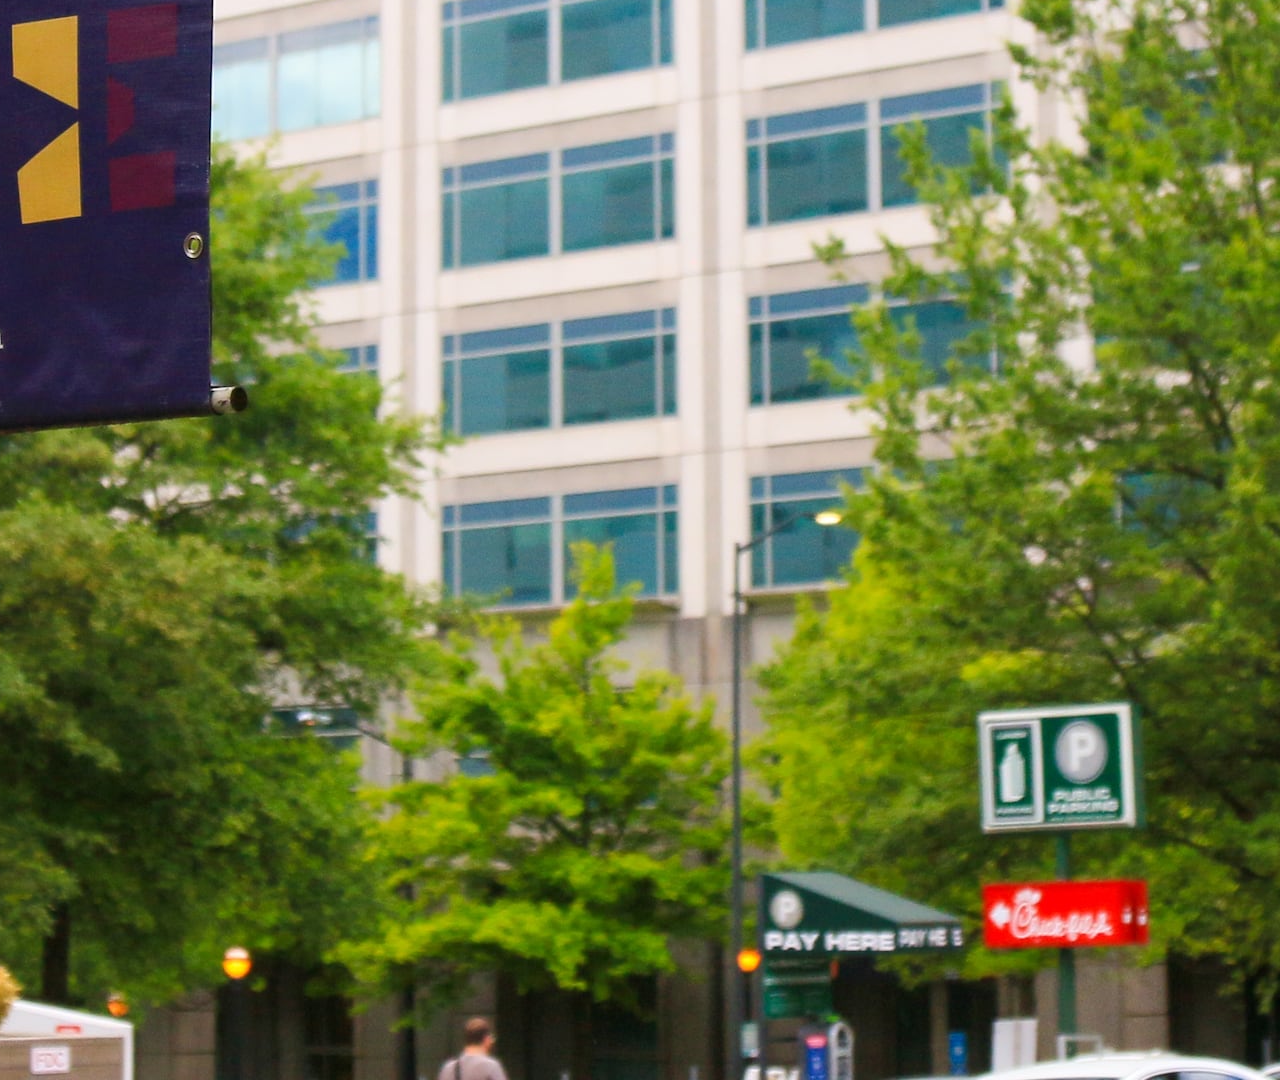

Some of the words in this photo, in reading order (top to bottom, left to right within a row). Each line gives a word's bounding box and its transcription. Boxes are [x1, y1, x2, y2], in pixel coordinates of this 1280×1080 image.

[1070, 730, 1100, 771] P
[1052, 788, 1111, 803] PUBLIC
[1047, 799, 1119, 815] PARKING
[764, 930, 820, 952] PAY
[823, 930, 897, 952] HERE
